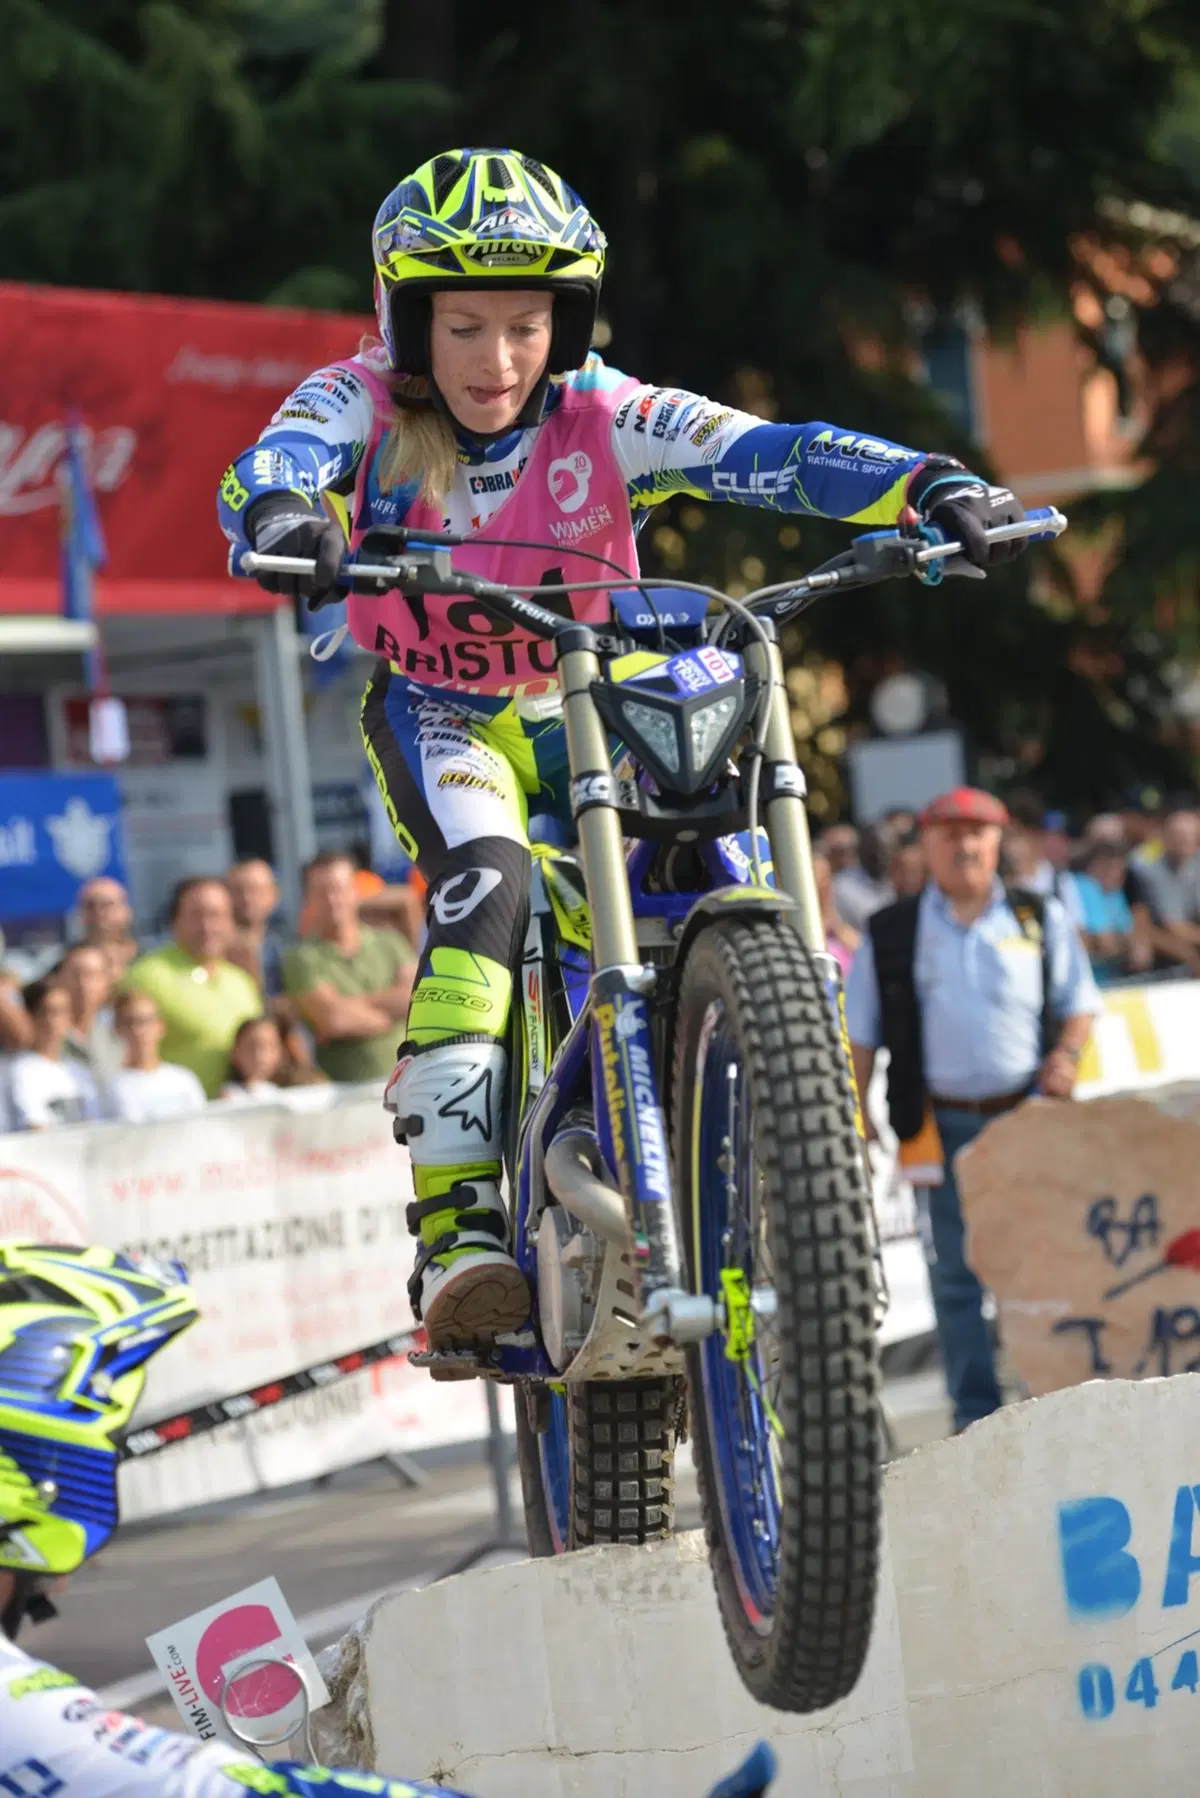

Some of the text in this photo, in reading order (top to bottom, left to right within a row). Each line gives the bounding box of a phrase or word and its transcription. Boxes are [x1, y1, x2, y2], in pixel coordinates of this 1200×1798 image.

[807, 455, 859, 473] RATHMELL
[375, 624, 558, 681] BRISTO
[411, 987, 494, 1013] ERCO
[628, 1044, 668, 1198] MICHELIN
